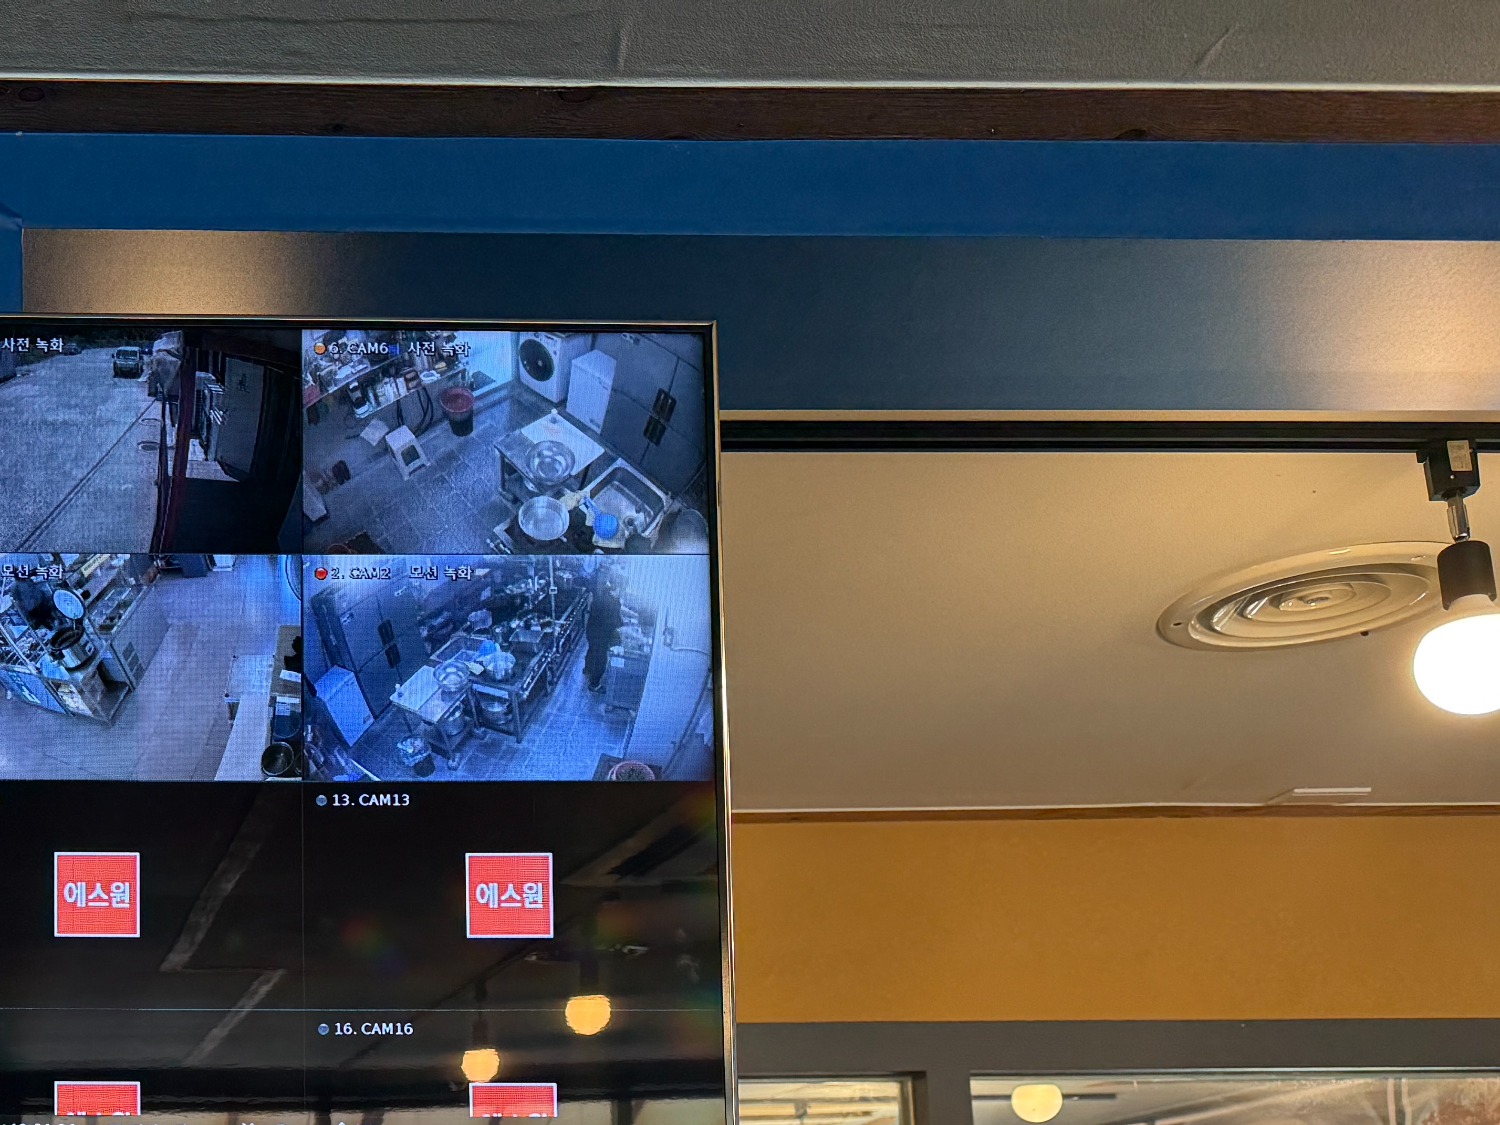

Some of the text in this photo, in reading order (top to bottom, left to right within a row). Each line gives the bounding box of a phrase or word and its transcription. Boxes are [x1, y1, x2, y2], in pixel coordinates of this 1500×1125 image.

[1, 338, 31, 352] 사전
[35, 338, 64, 352] 녹화
[349, 343, 389, 355] CAM6
[408, 342, 436, 356] 사전
[441, 342, 470, 357] 녹화
[35, 564, 64, 579] 녹화
[349, 567, 391, 580] CAM2
[443, 566, 472, 581] 녹화
[332, 794, 410, 806] 13. CAM13
[63, 881, 130, 908] 에스원
[475, 882, 543, 909] 에스원
[334, 1023, 414, 1036] 16. CAM16
